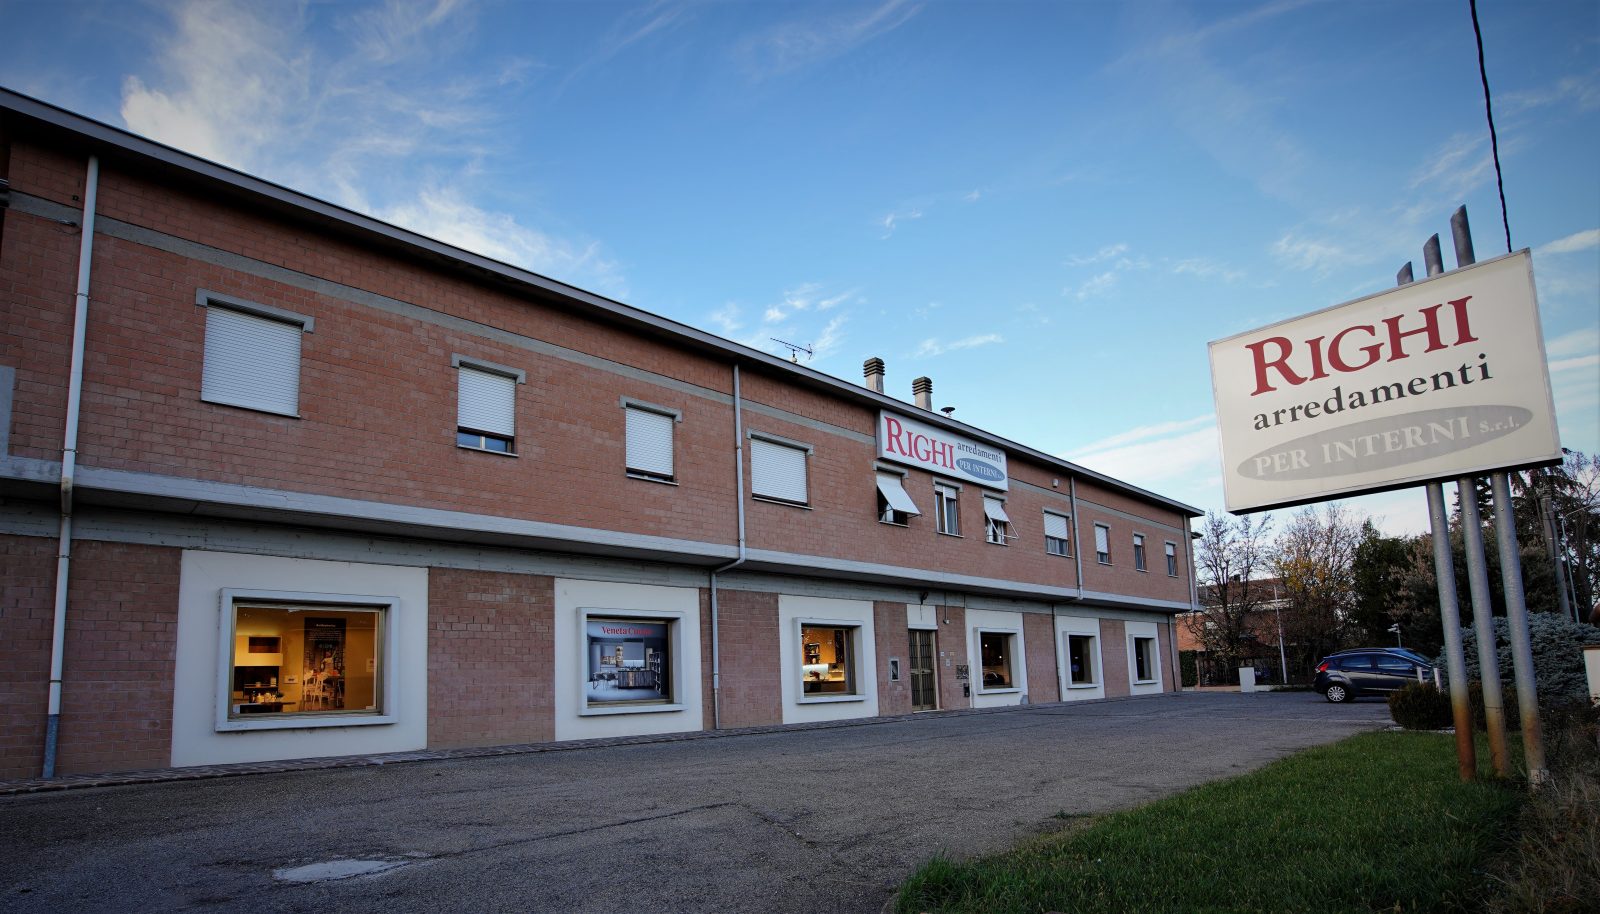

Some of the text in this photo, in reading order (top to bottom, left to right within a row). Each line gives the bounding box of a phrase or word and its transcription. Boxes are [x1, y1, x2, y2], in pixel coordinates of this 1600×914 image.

[1245, 295, 1479, 397] RIGHI
[1254, 353, 1493, 431] arredamenti
[884, 416, 956, 470] RIGHI
[957, 441, 1002, 463] arredamenti
[959, 460, 971, 471] PER
[1254, 449, 1310, 477] PER
[1321, 416, 1472, 464] INTERNI
[602, 626, 627, 635] Veneta
